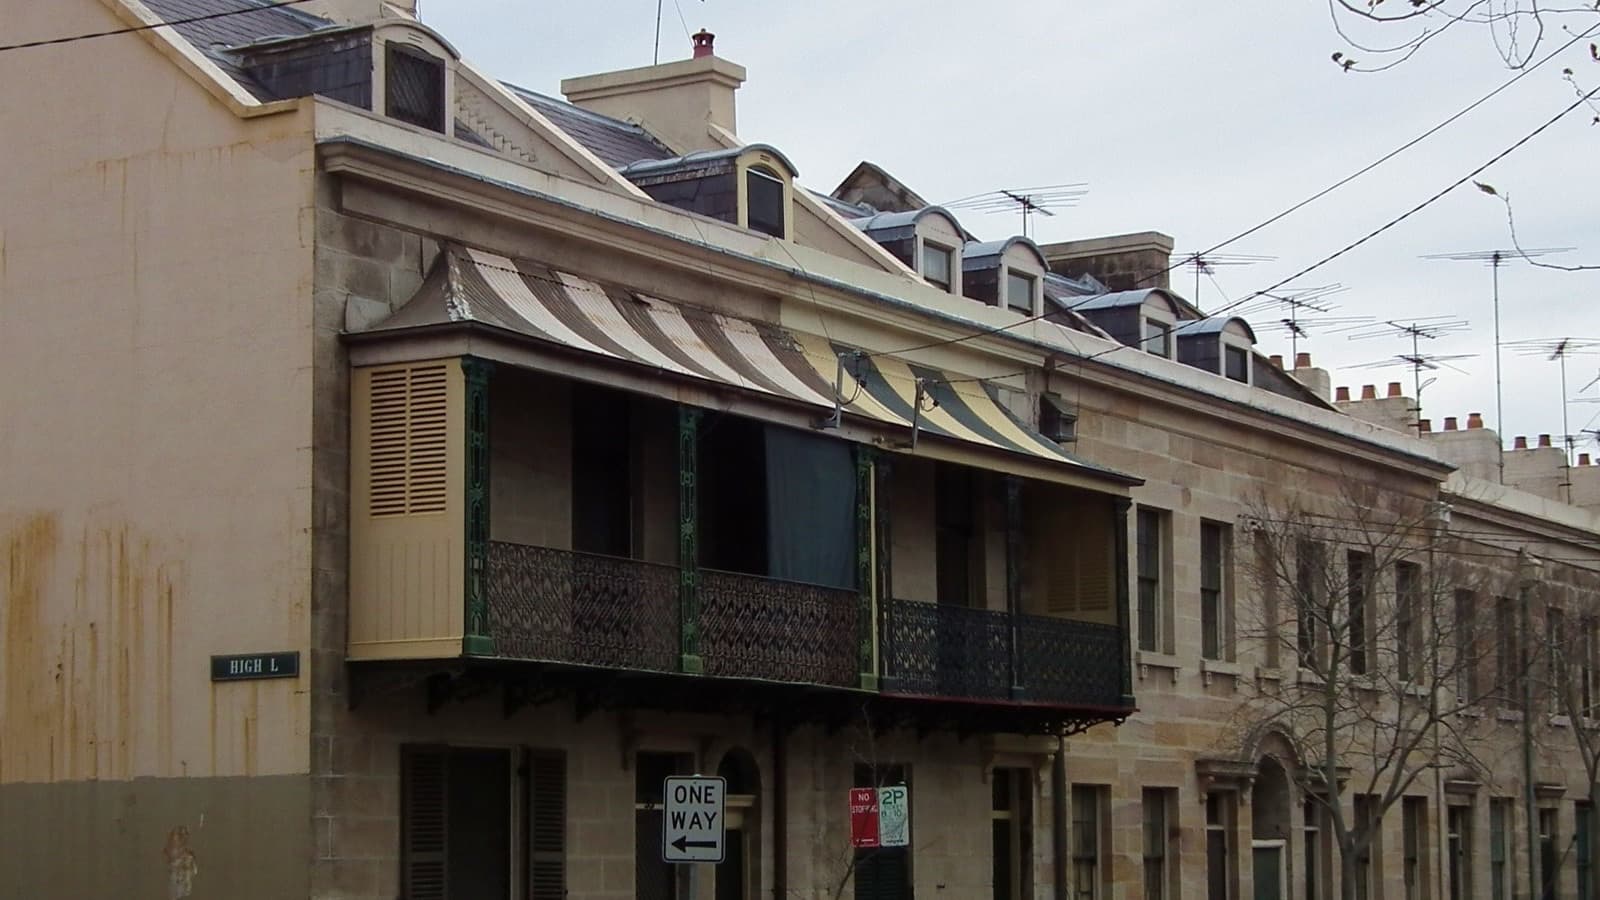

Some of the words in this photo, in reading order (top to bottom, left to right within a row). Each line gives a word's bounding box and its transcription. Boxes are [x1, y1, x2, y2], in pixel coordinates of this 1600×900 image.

[230, 658, 262, 674] HIGH
[271, 657, 279, 672] L
[674, 785, 716, 804] ONE
[858, 793, 870, 801] NO
[881, 790, 904, 804] 2P
[671, 811, 717, 830] WAY
